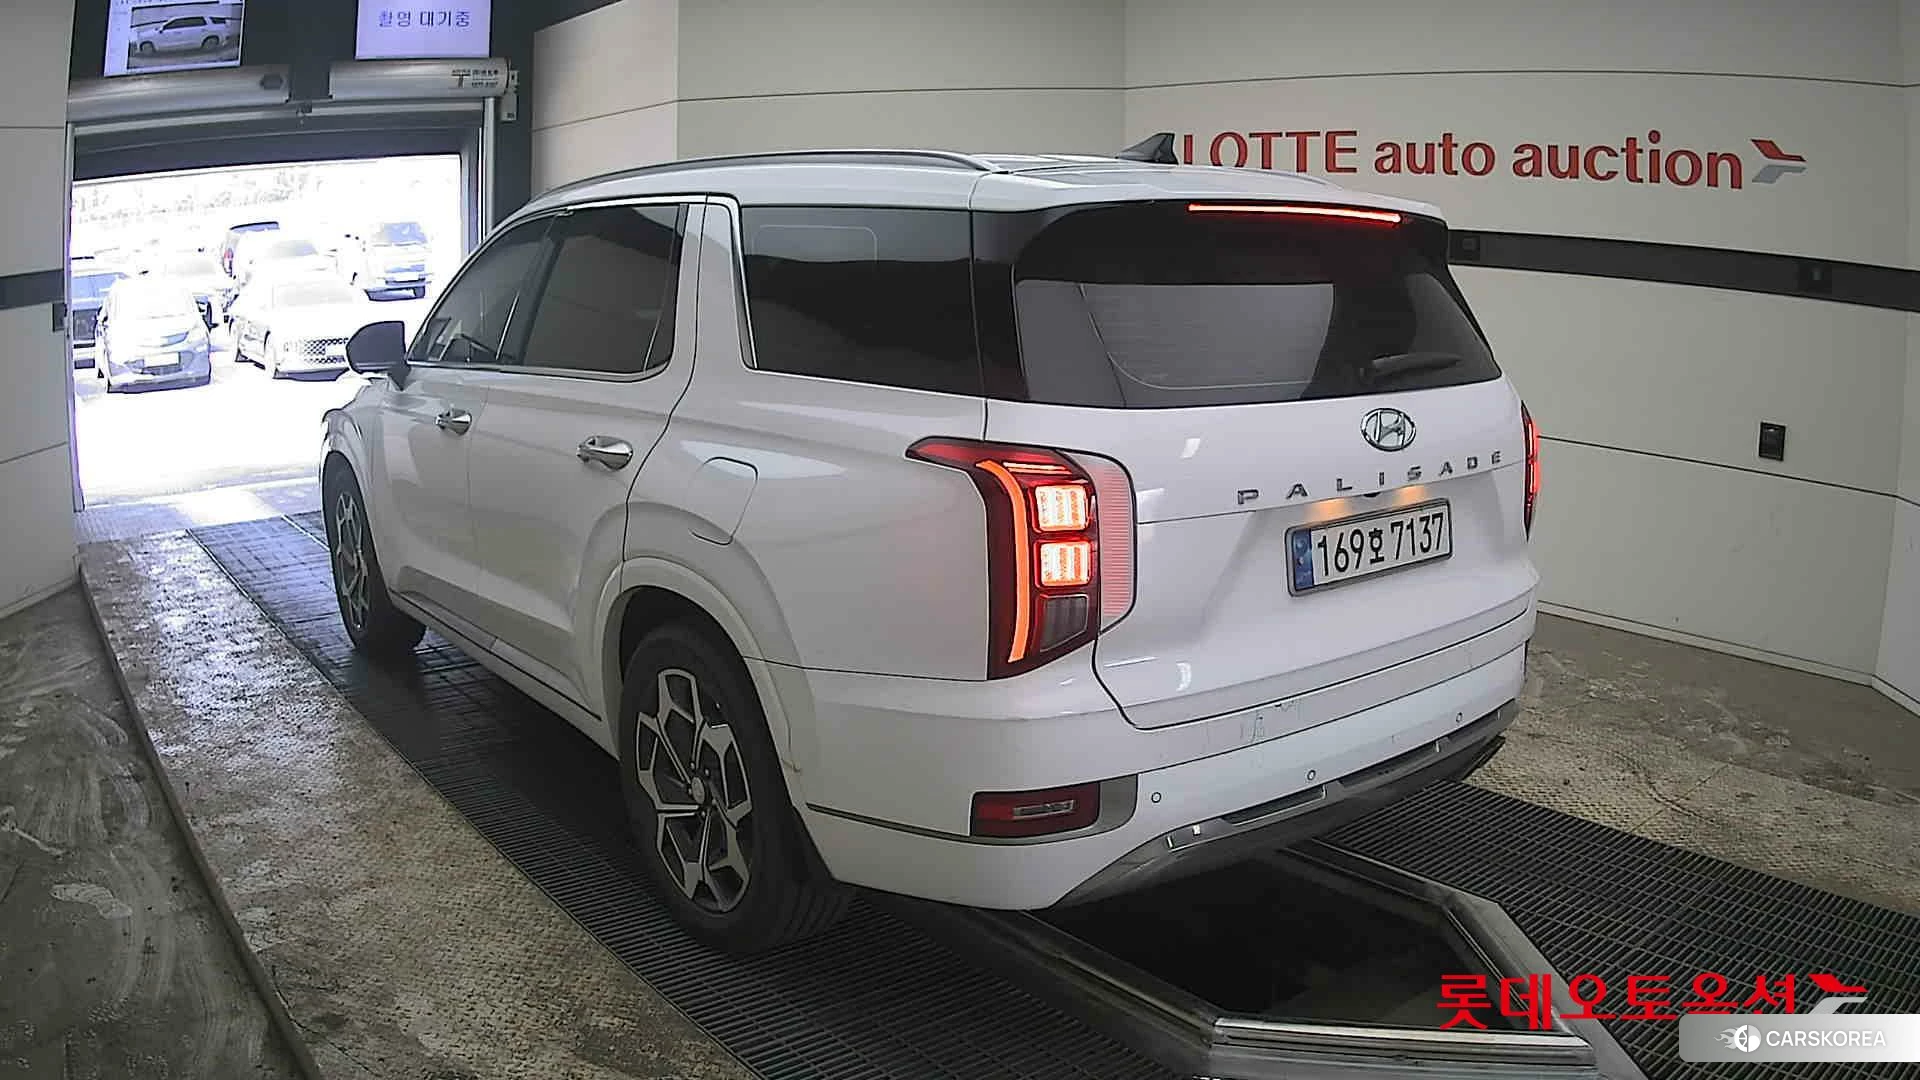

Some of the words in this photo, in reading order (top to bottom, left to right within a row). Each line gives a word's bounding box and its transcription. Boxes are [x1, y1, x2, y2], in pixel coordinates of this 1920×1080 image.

[419, 10, 470, 28] 대기중
[1374, 132, 1495, 176] auto
[1512, 130, 1744, 190] auction
[1237, 451, 1501, 504] PALISADE
[1317, 526, 1385, 577] 169호
[1390, 512, 1444, 561] 7137
